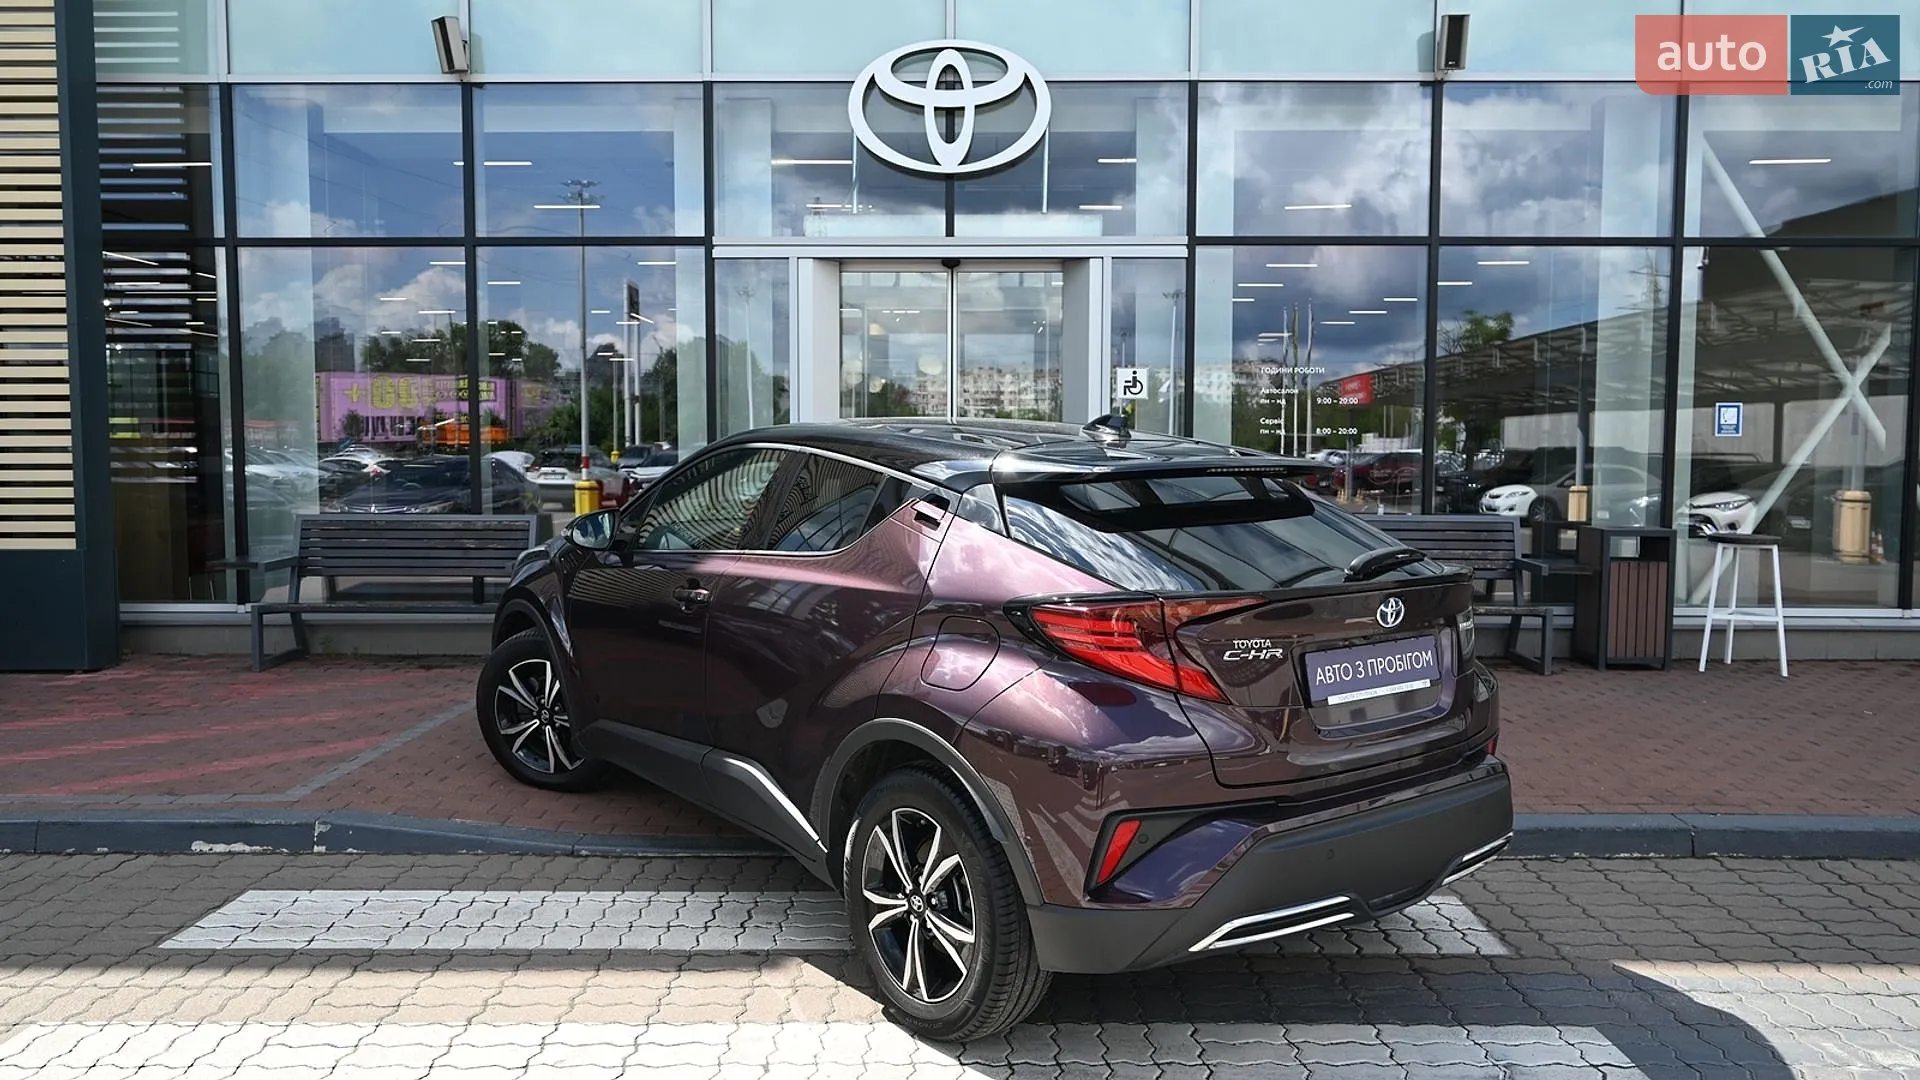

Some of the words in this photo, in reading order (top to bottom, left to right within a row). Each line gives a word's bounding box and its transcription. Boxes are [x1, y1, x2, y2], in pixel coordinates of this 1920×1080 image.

[1261, 367, 1292, 375] ГОДИНИ
[1294, 367, 1325, 375] РОБОТИ
[1339, 397, 1359, 405] 20:00
[1316, 427, 1332, 435] 8:00
[1338, 427, 1358, 435] 20:00
[1233, 639, 1272, 649] TOYOTA
[1223, 648, 1283, 660] C-HR
[1316, 662, 1353, 686] АВТО
[1367, 649, 1433, 677] ПРОБІГОМ
